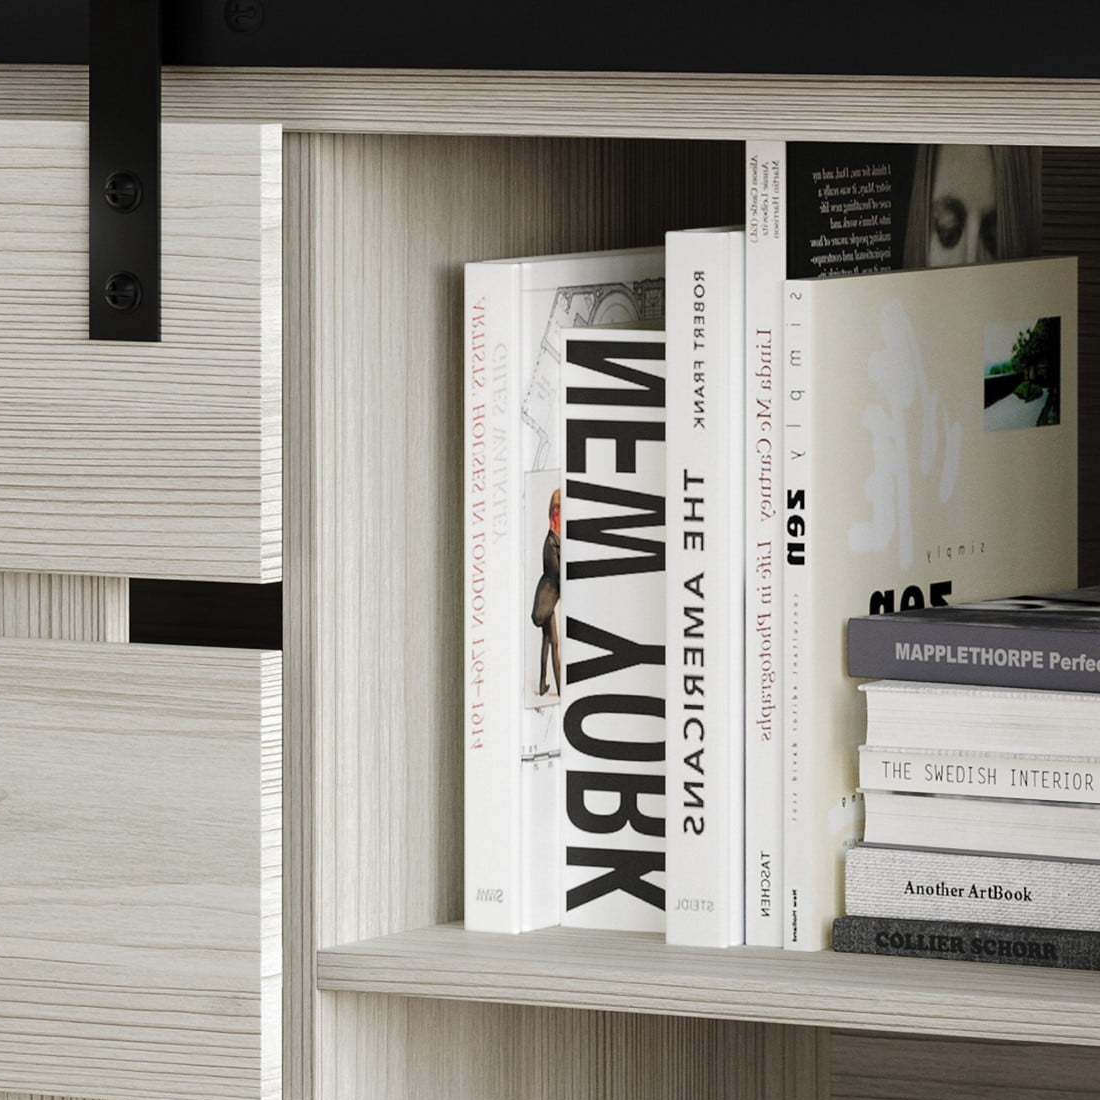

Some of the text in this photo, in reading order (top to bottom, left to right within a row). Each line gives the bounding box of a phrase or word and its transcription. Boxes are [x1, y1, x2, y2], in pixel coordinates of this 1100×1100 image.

[895, 642, 1044, 668] MAPPLETHORPE
[882, 761, 1093, 791] THE SWEDISH INTERIOR
[904, 881, 1032, 901] Another ArtBook
[876, 931, 1058, 961] COLLIER SCHORR
